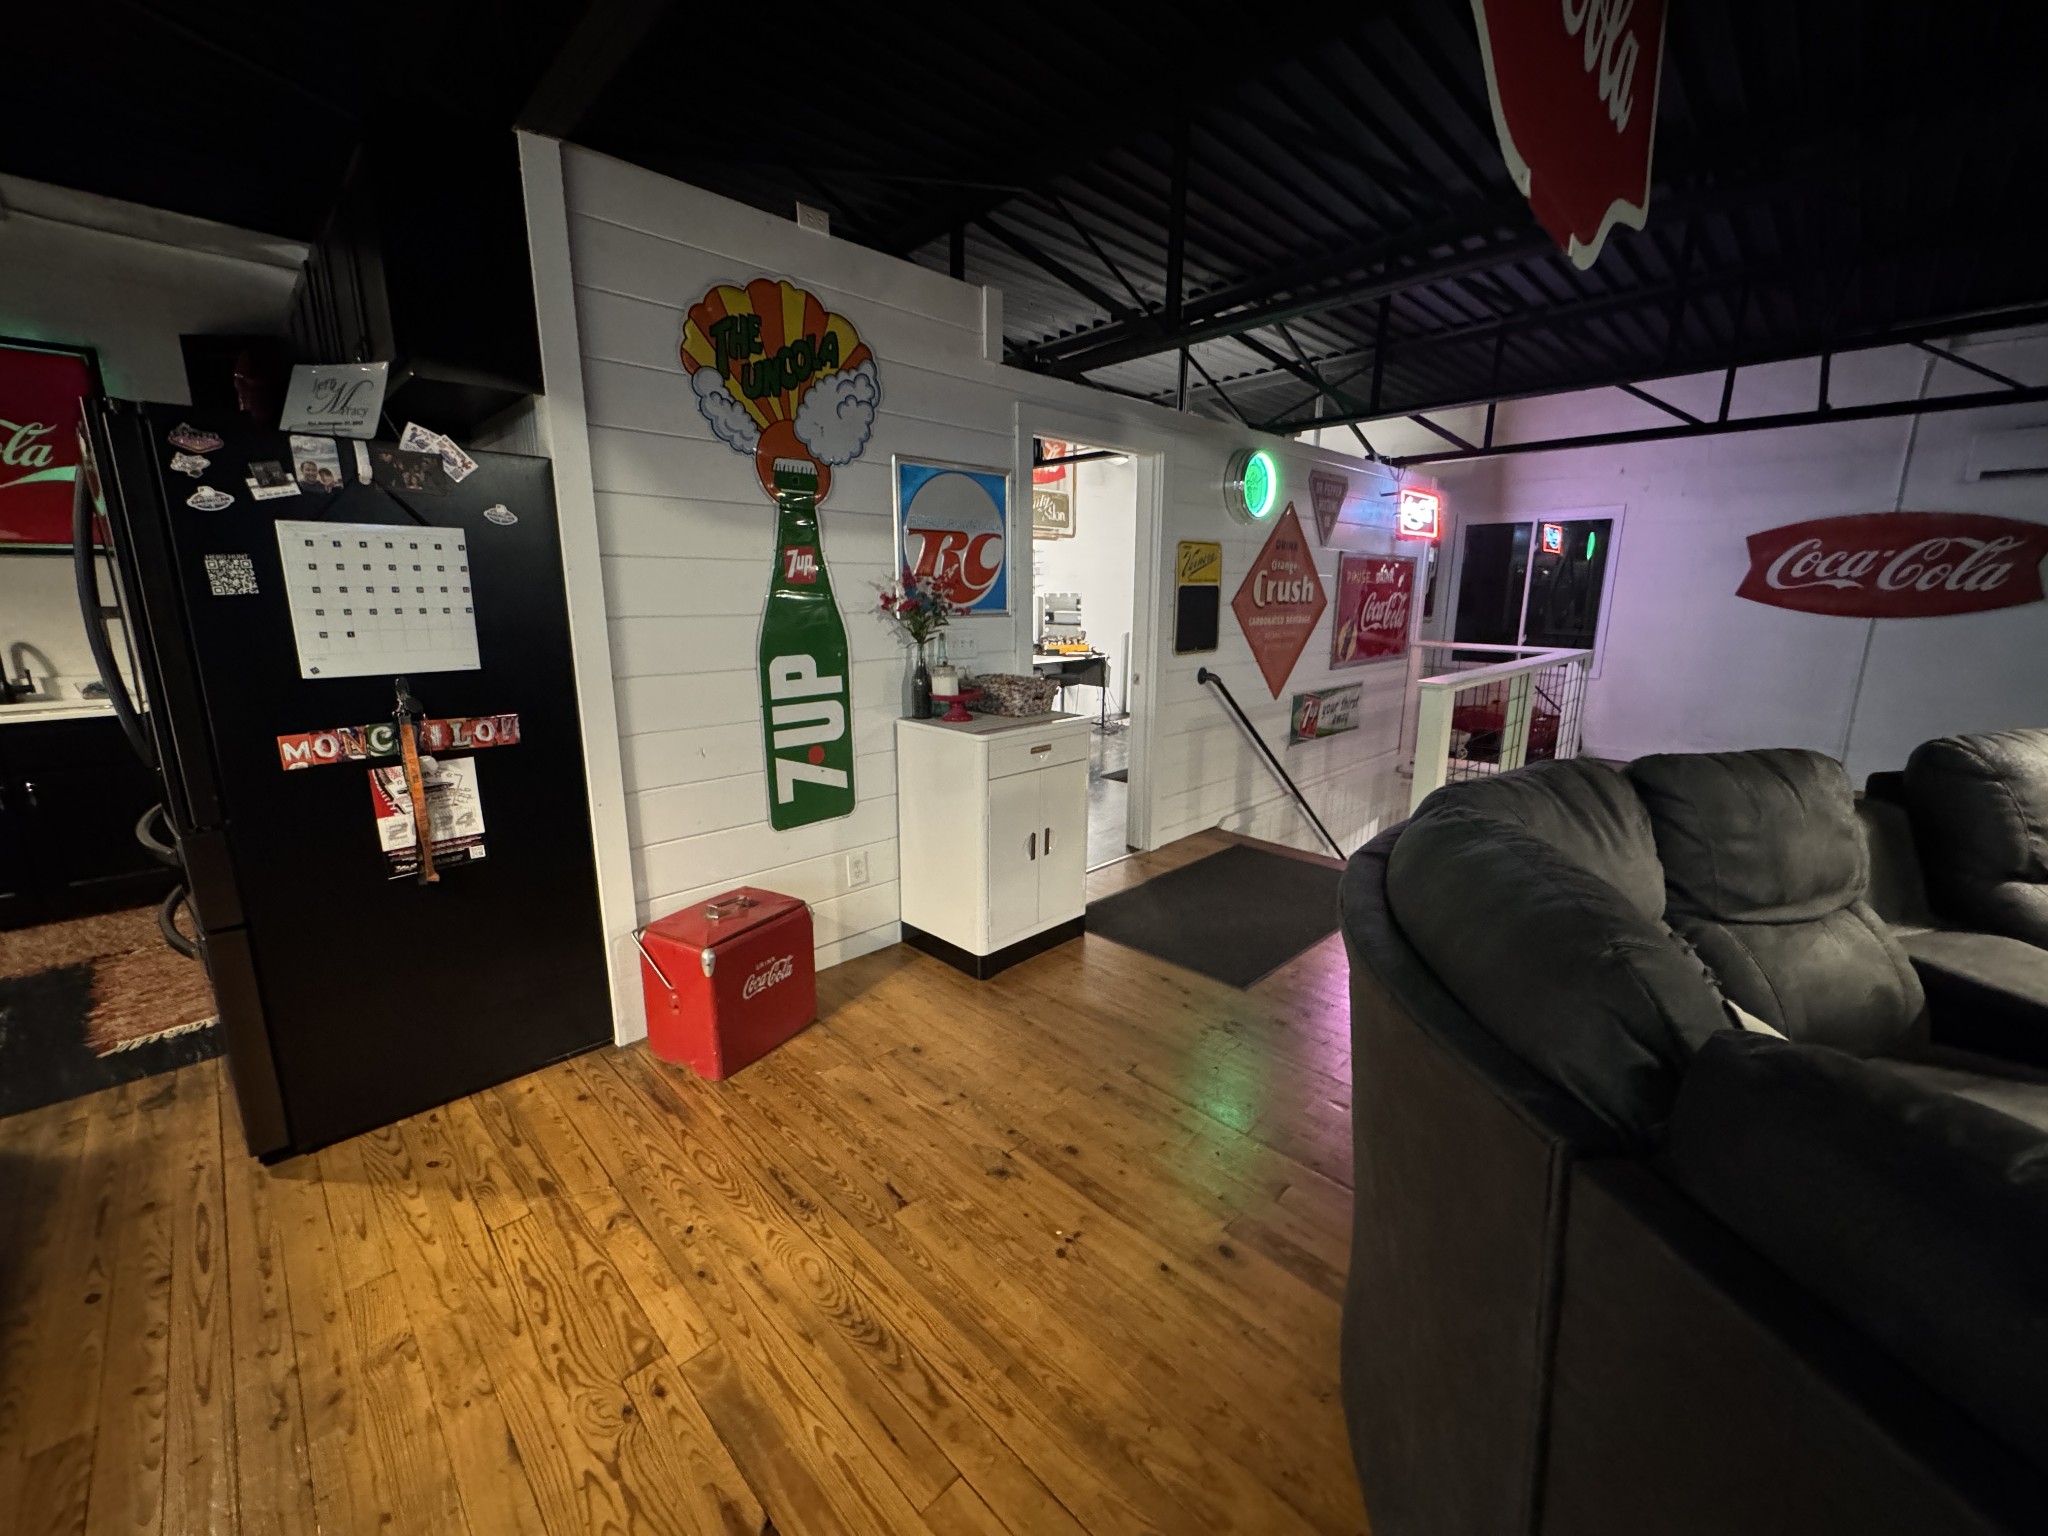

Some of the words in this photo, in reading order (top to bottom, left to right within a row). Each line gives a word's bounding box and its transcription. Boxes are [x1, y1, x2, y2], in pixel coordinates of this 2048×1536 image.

[709, 312, 764, 380] THE
[741, 331, 839, 399] UNCOLA
[907, 528, 1003, 604] RC
[1253, 569, 1315, 608] Crush
[1271, 560, 1298, 575] Orange
[1766, 536, 2028, 592] Coca-Cola
[1248, 615, 1285, 627] CARBONATED
[743, 954, 794, 1000] Coca-Cola
